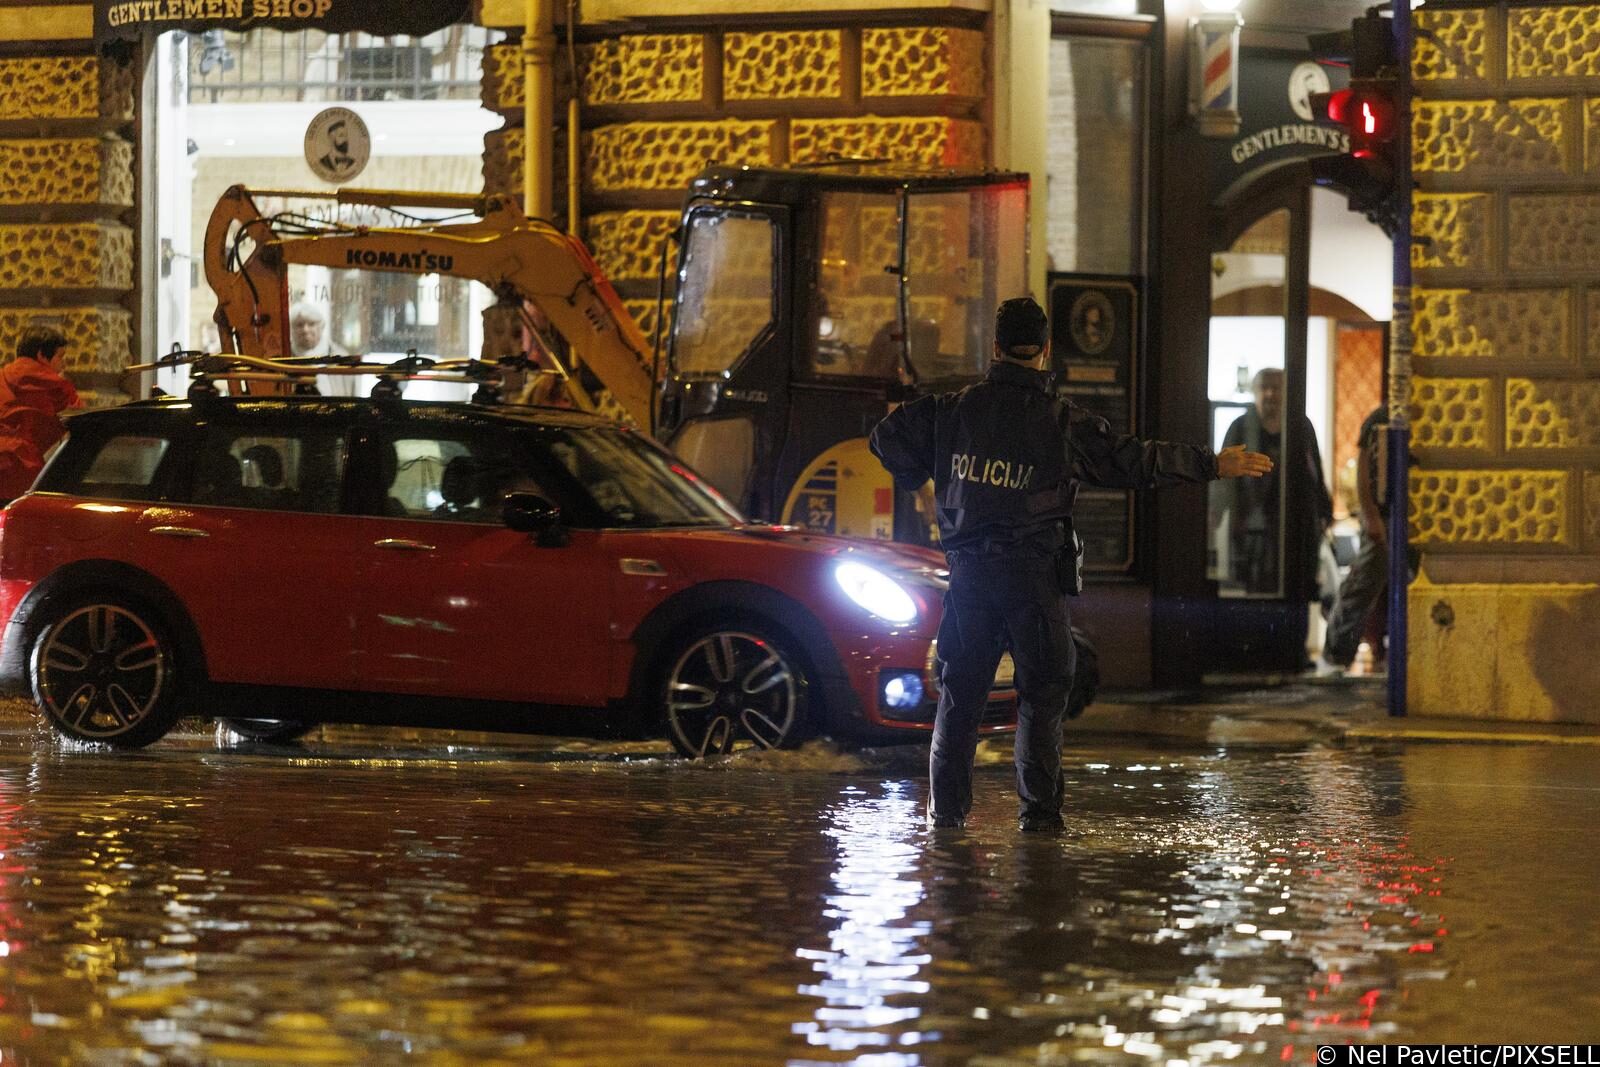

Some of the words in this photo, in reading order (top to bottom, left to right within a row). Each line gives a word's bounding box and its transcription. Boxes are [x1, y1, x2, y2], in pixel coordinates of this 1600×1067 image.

[108, 0, 243, 26] GENTLEMEN
[252, 0, 332, 19] SHOP
[1231, 124, 1340, 164] GENTLEMEN'S
[346, 249, 454, 271] KOMATSU
[951, 453, 1035, 490] POLICIJA
[809, 510, 833, 527] 27
